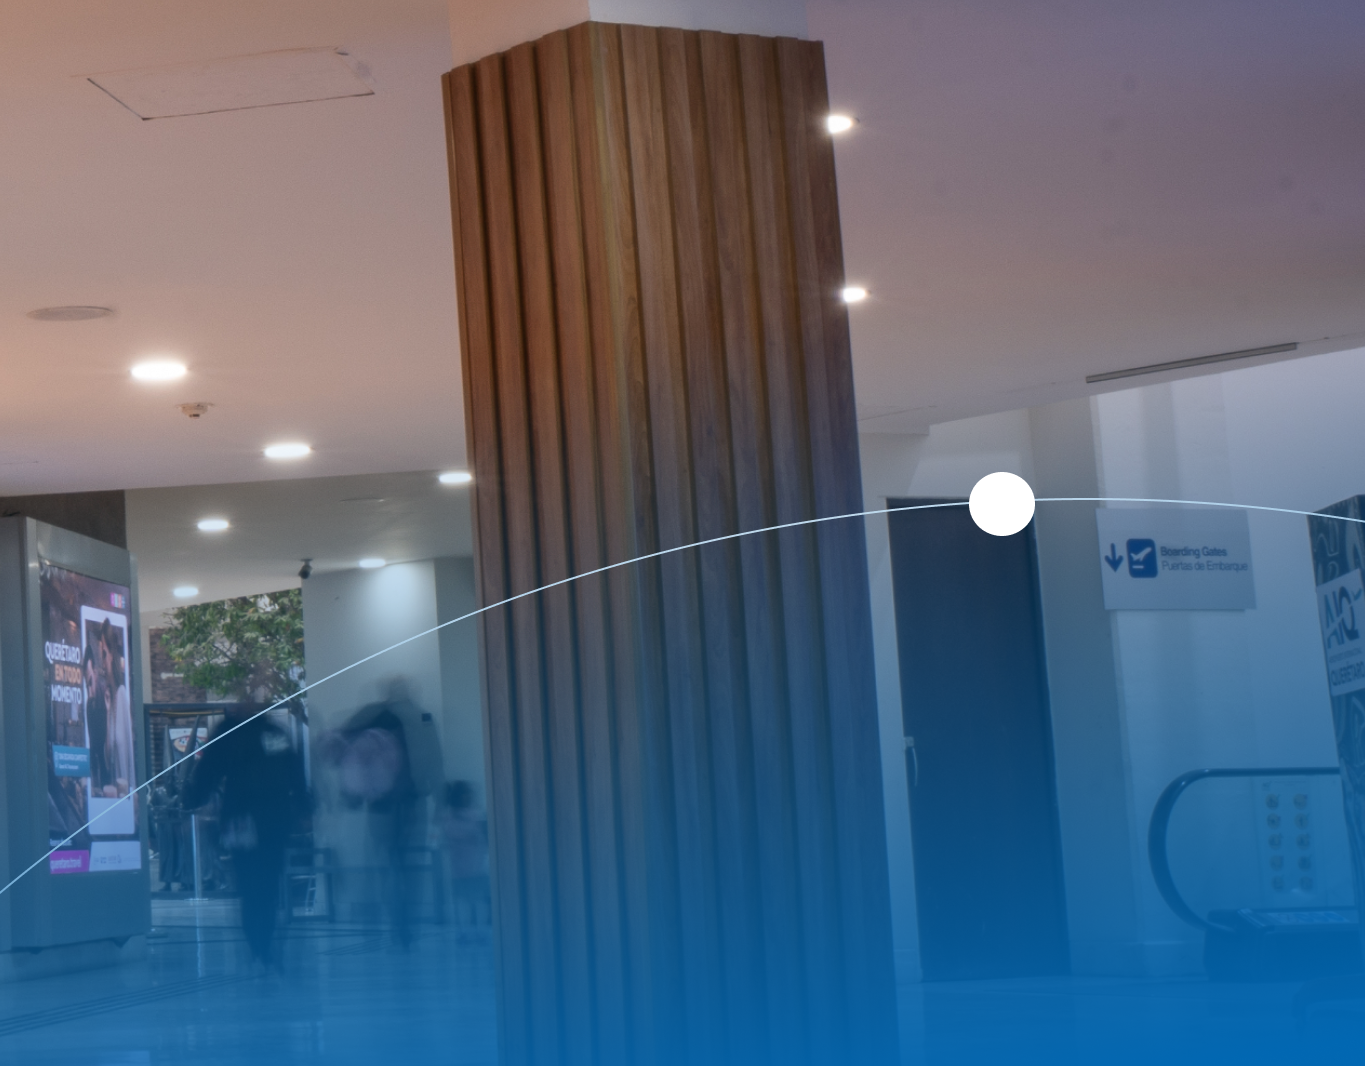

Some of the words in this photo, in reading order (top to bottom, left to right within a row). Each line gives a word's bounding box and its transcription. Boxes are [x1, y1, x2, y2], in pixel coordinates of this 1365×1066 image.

[1161, 546, 1200, 559] Boarding
[1201, 546, 1227, 557] Gates
[1161, 560, 1193, 571] Puertas
[1194, 561, 1205, 571] de
[1206, 560, 1248, 573] Embarque
[45, 638, 81, 664] QUERÉTARO
[64, 665, 81, 684] TODO
[51, 684, 82, 705] MOMENTO
